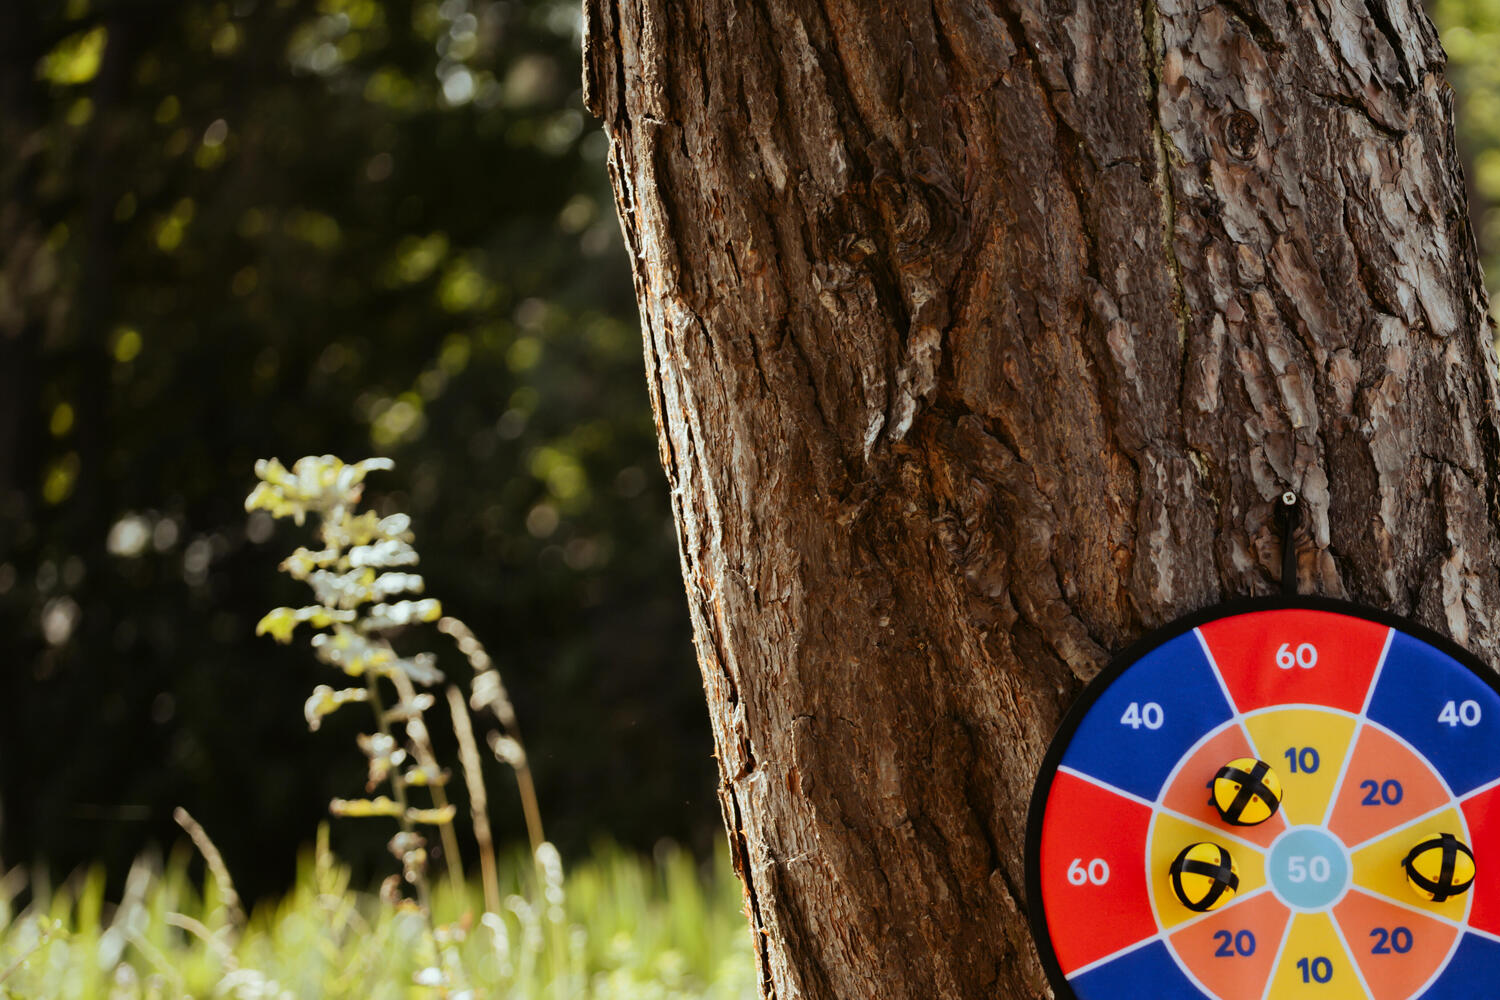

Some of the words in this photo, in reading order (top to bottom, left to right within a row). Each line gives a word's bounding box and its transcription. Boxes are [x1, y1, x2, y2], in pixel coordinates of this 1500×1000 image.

[1276, 643, 1317, 669] 60
[1121, 703, 1163, 729] 40
[1438, 700, 1481, 726] 40
[1285, 747, 1320, 774] 10
[1360, 780, 1403, 806] 20
[1067, 859, 1109, 885] 60
[1288, 856, 1330, 883] 50
[1214, 930, 1256, 957] 20
[1370, 927, 1413, 954] 20
[1297, 957, 1333, 983] 10
